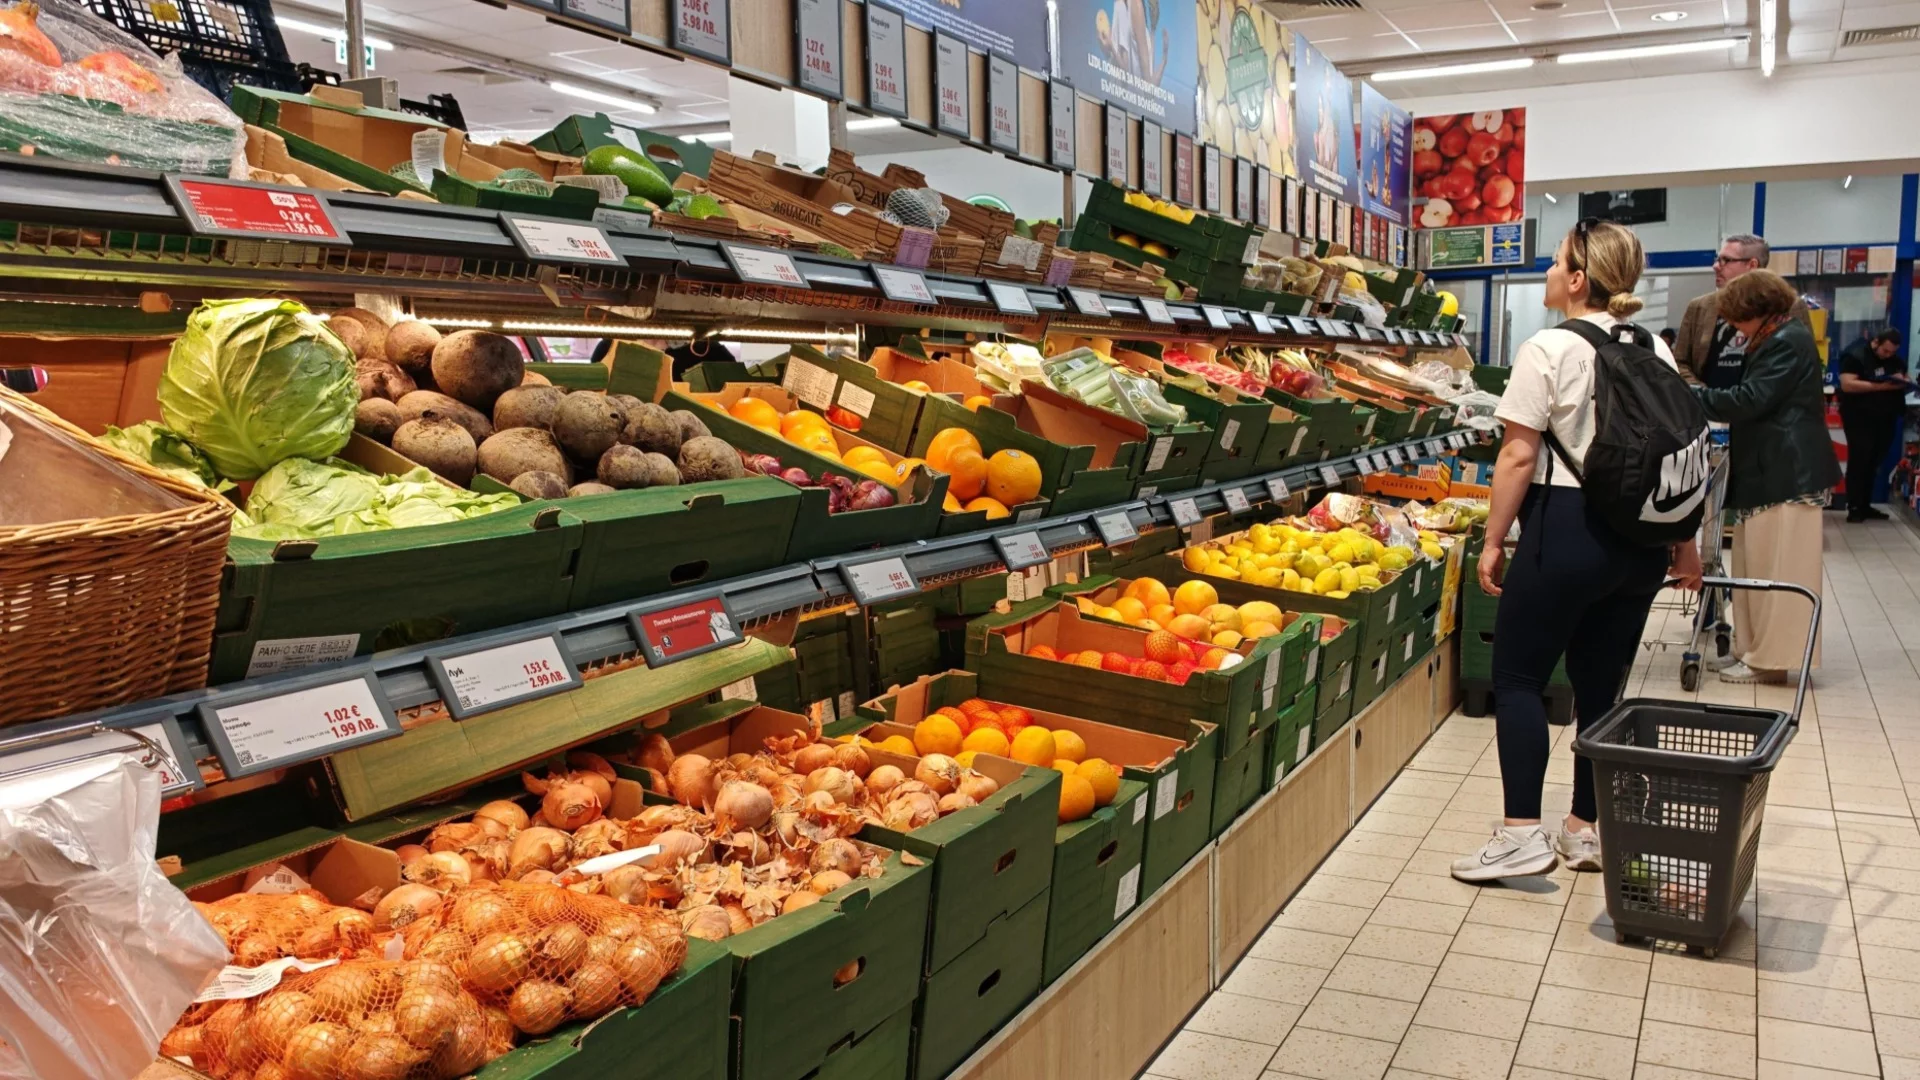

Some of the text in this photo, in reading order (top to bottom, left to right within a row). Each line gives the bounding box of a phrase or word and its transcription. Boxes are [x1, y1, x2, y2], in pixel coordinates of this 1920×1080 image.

[703, 2, 709, 15] €
[683, 13, 701, 29] 5.98
[806, 38, 824, 56] 1.27 €
[806, 54, 820, 70] 2.48
[875, 62, 892, 78] 2.99 €
[875, 78, 887, 92] 5.85
[1087, 53, 1175, 105] LIDL ПОМАГА ЗА РАЗВИТИЕТО НА
[954, 91, 958, 102] €
[1101, 78, 1165, 117] БЪЛГАРСКИЯ ВОЛЕЙБОЛ
[279, 209, 314, 223] 0.79 €
[773, 202, 824, 228] AGUACATE
[285, 222, 308, 234] 1.55
[577, 239, 600, 249] 1.02 €
[583, 248, 599, 258] 1.99
[1656, 425, 1710, 502] NIKE
[1419, 465, 1438, 480] Jumbo
[258, 646, 290, 656] РАННО
[448, 667, 465, 678] Лук
[523, 659, 550, 675] 1.53 €
[529, 674, 549, 688] 2.99
[324, 705, 361, 724] 1.02 €
[331, 722, 357, 739] 1.99
